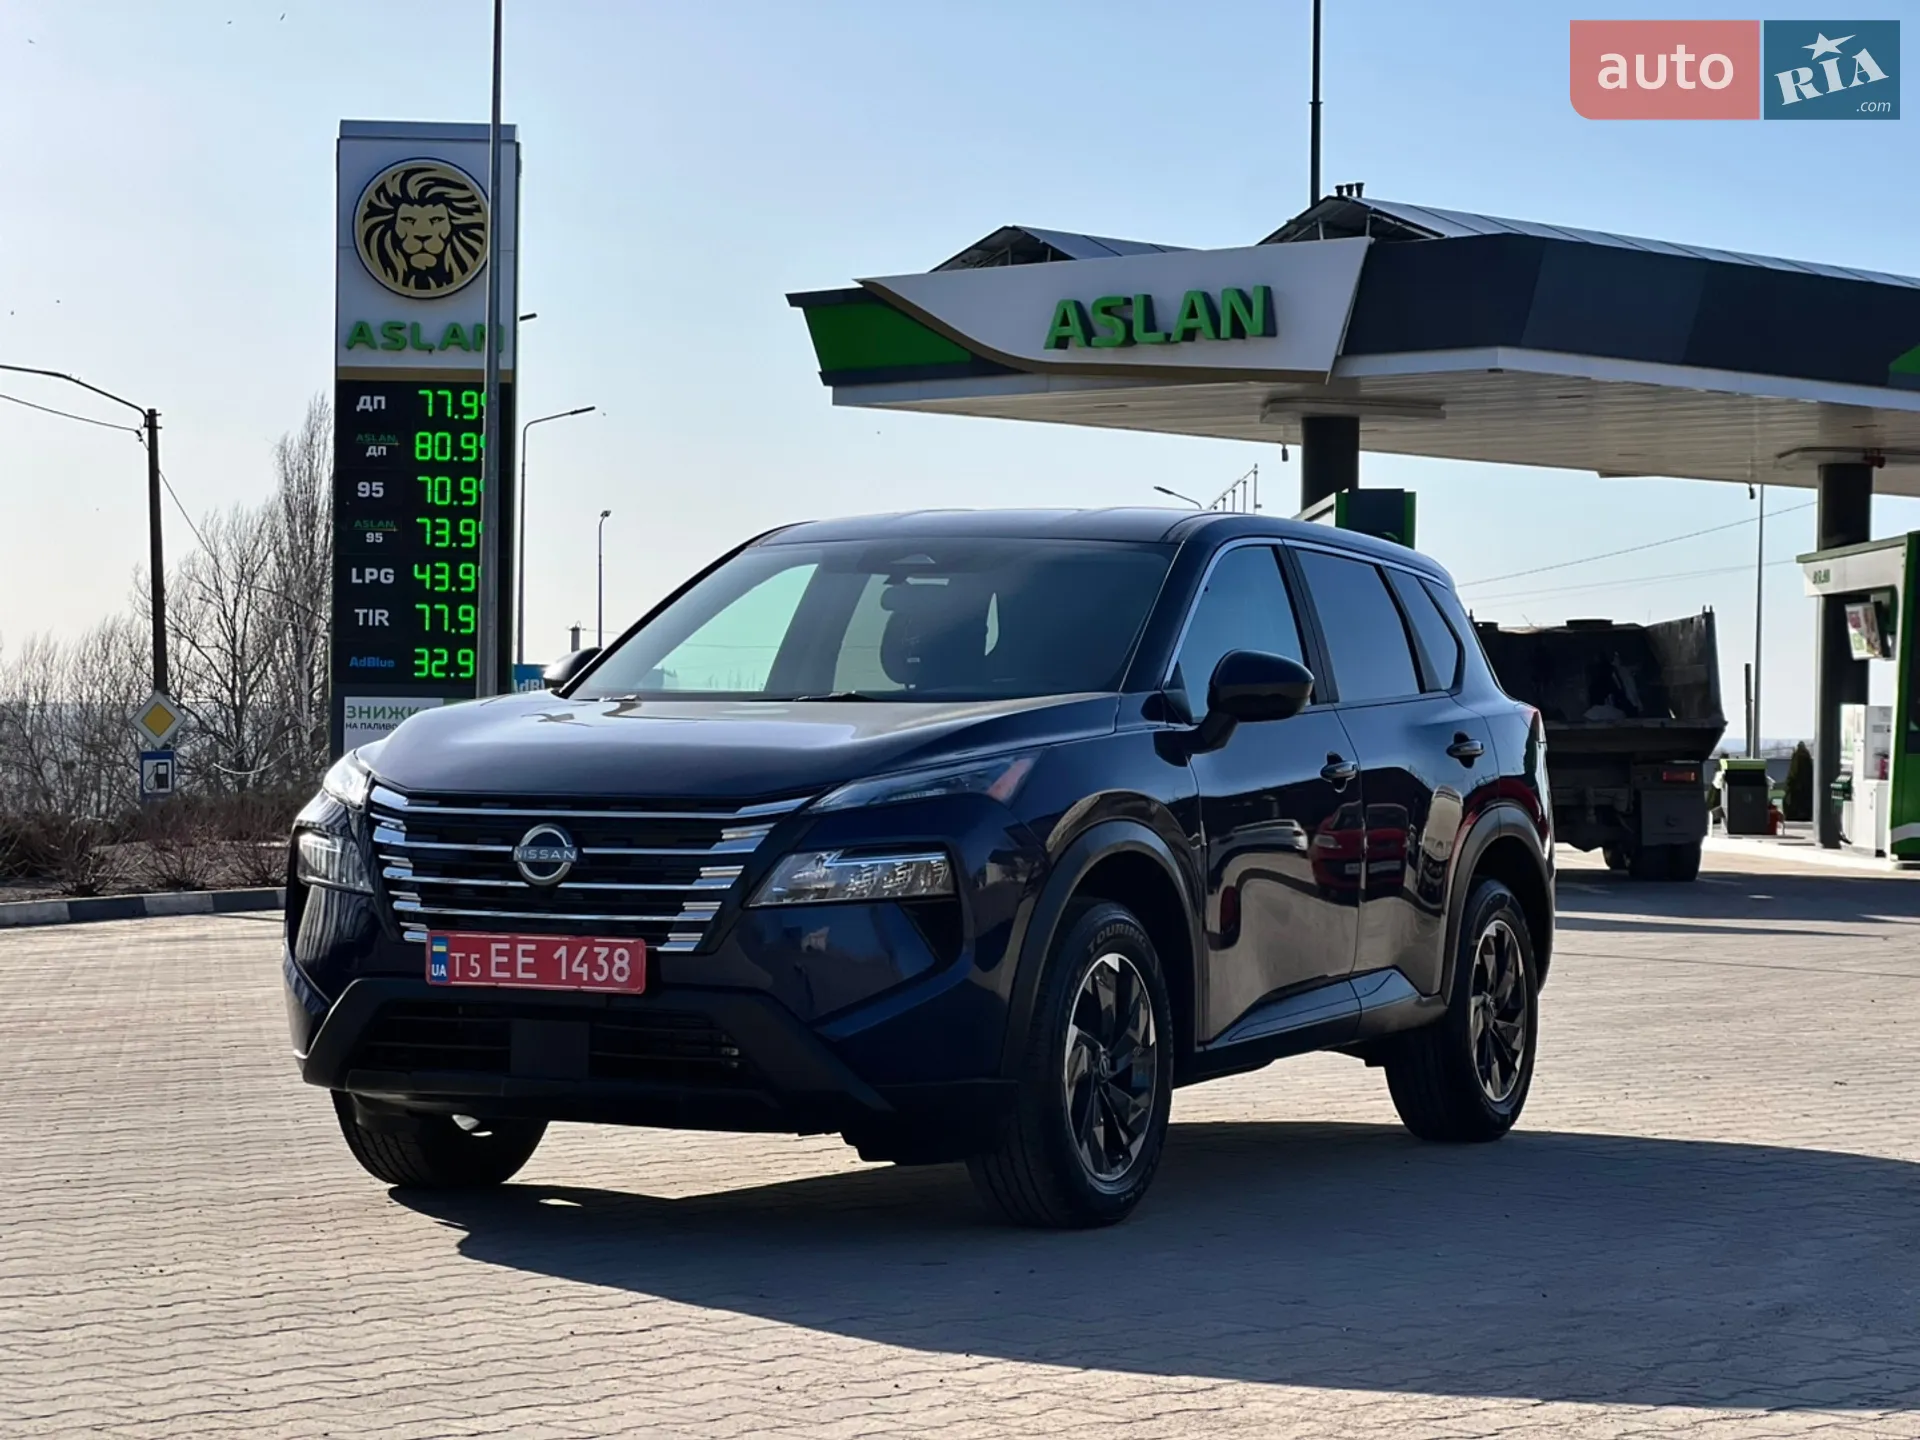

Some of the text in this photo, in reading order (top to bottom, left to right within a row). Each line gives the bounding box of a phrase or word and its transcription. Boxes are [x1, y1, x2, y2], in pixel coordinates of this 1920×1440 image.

[1043, 284, 1277, 350] ASLAN
[356, 395, 386, 412] ДП
[355, 433, 397, 442] ASLAN
[366, 445, 387, 458] ДП
[357, 476, 485, 506] 95 70.9
[353, 518, 484, 548] ASLAN 73.9
[365, 532, 384, 543] 95
[351, 562, 481, 592] LPG 43.9
[354, 609, 390, 627] TIR
[349, 656, 395, 668] AdBlue
[346, 705, 428, 719] ЗНИЖК
[345, 722, 358, 730] НА
[514, 848, 576, 860] NISSAN
[431, 963, 447, 977] UA
[450, 943, 631, 983] T5 EE 1438
